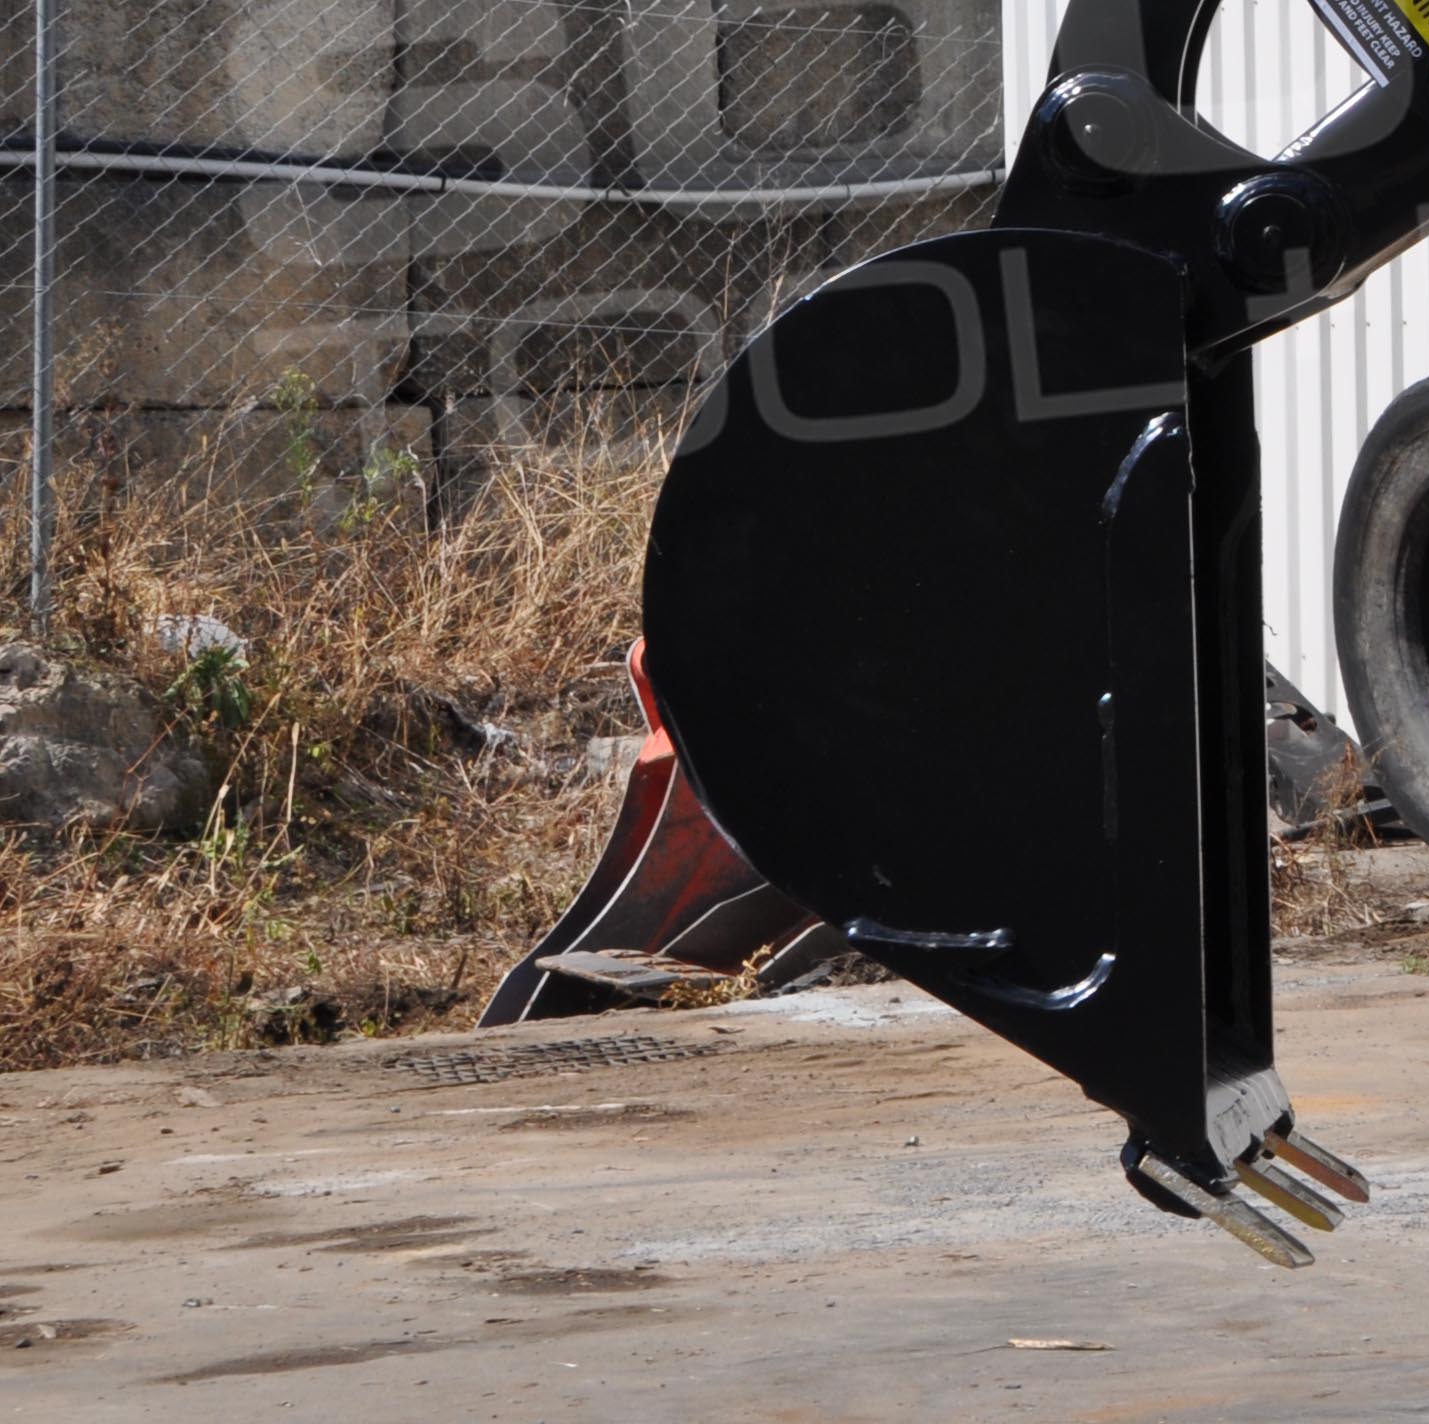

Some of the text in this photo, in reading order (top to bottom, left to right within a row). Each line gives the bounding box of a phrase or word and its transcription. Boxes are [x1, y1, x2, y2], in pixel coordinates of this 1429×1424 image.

[1338, 0, 1358, 21] AND
[1354, 19, 1372, 42] FEET
[1370, 39, 1395, 70] CLEAR
[1356, 3, 1384, 36] INJURY
[1379, 34, 1401, 58] KEEP
[1384, 11, 1423, 59] HAZARD
